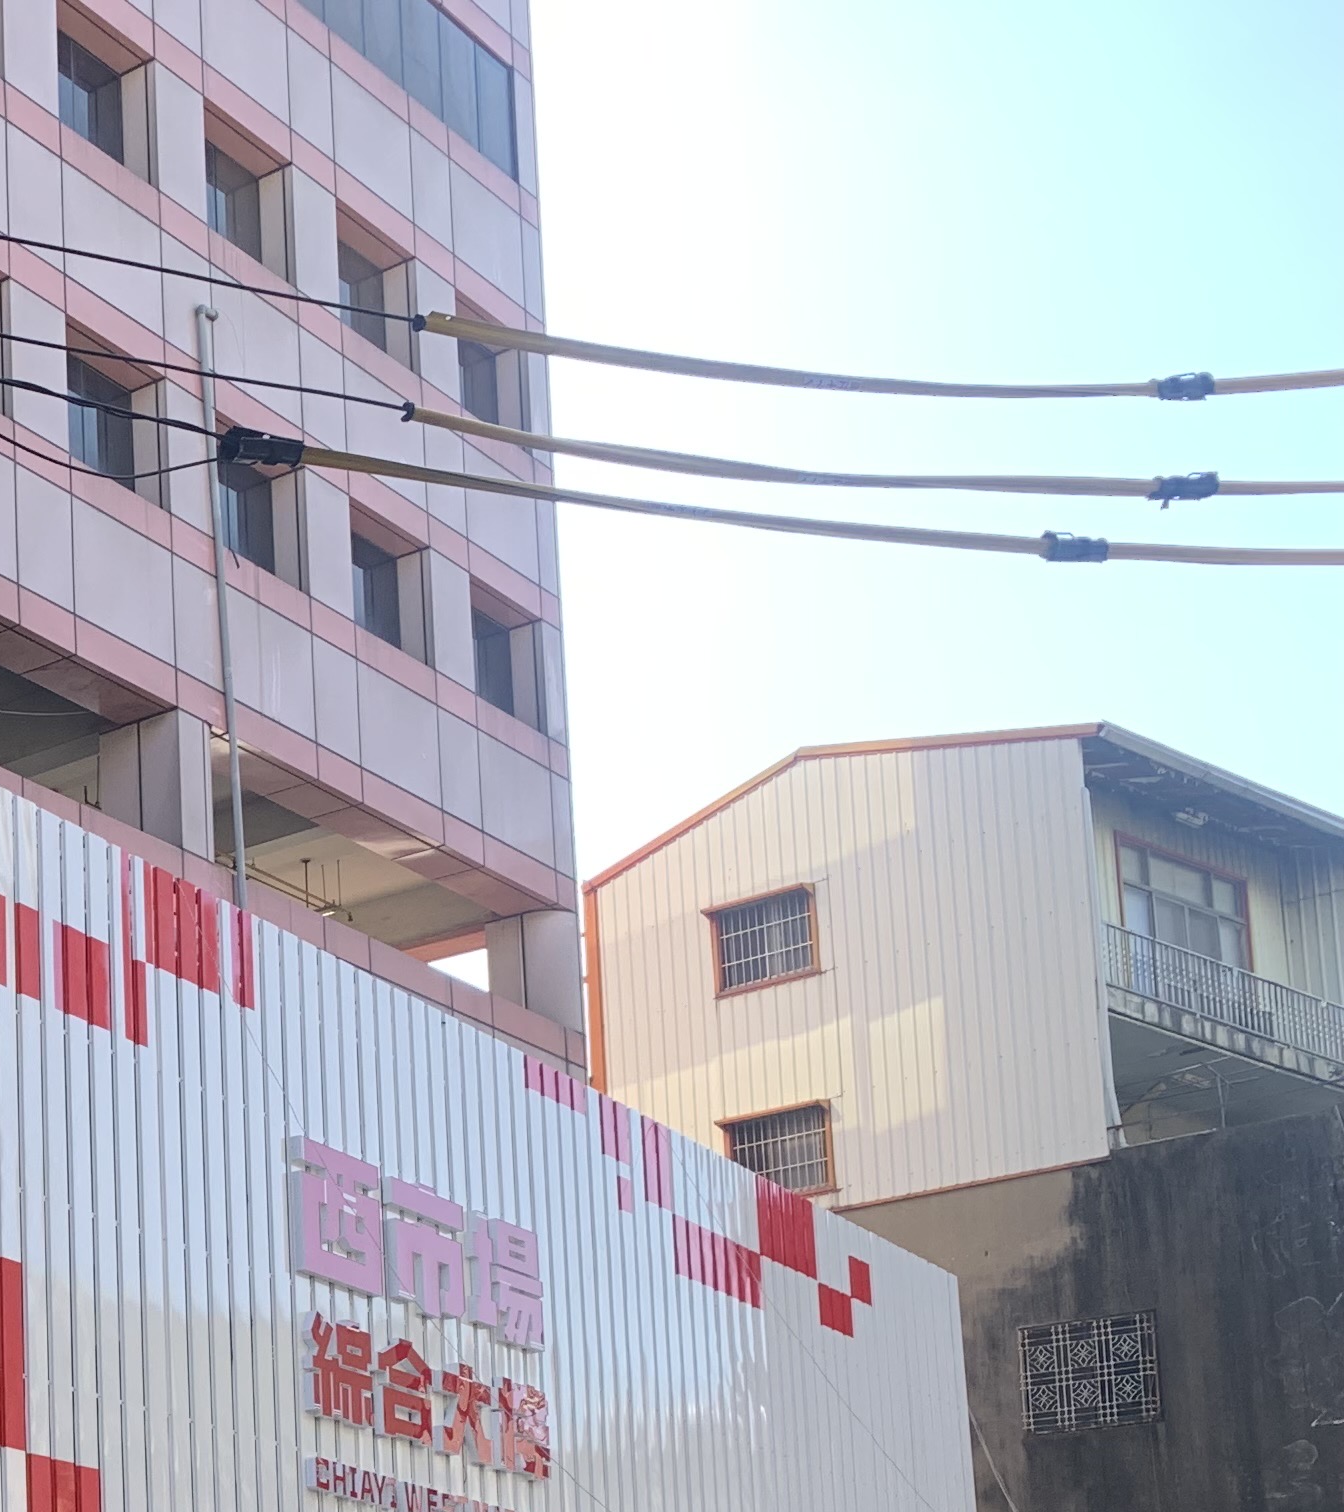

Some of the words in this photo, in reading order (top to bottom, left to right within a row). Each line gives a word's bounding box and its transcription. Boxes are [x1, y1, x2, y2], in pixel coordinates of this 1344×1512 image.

[296, 1136, 545, 1352] 西市場
[305, 1311, 552, 1481] 綜合大樓
[313, 1456, 397, 1510] CHIAYI
